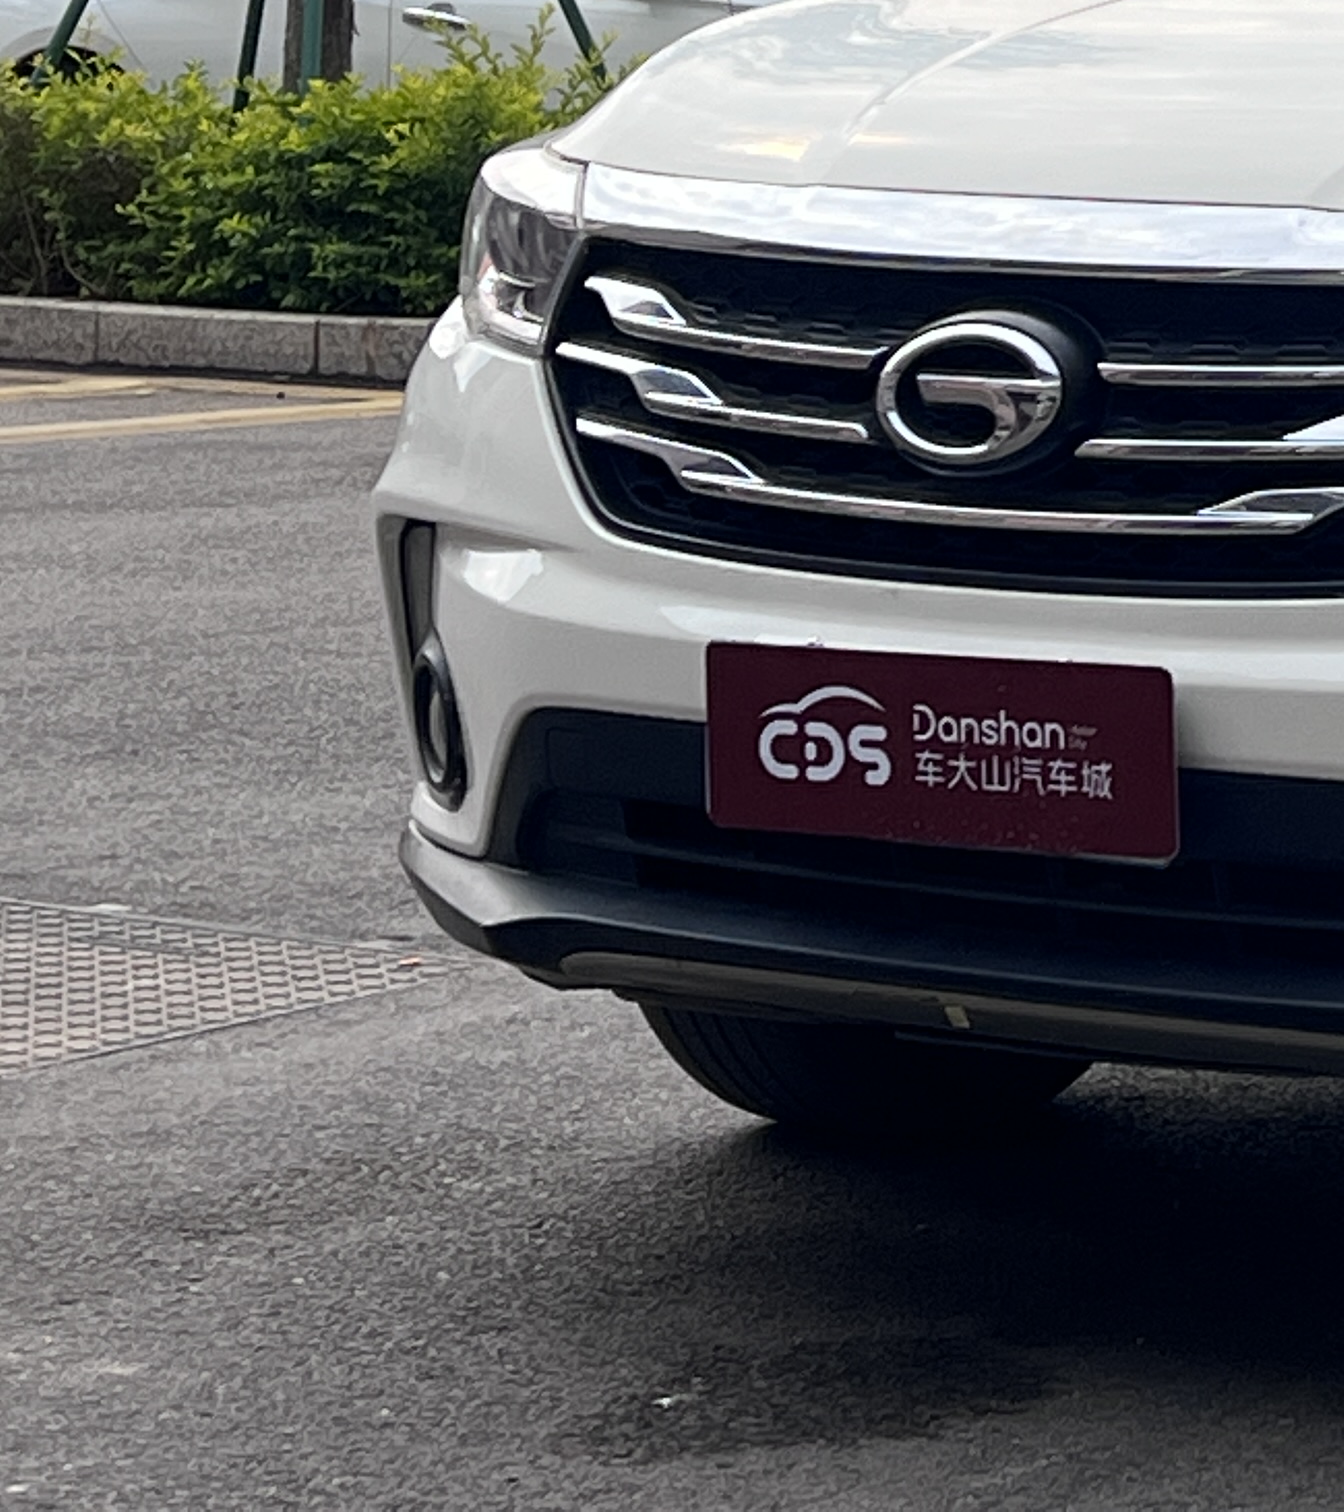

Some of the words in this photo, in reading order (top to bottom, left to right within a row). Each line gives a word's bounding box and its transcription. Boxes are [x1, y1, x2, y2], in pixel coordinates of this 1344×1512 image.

[912, 703, 1065, 750] Danshan
[758, 719, 892, 786] CDS
[914, 749, 1113, 799] 车大山汽车城
